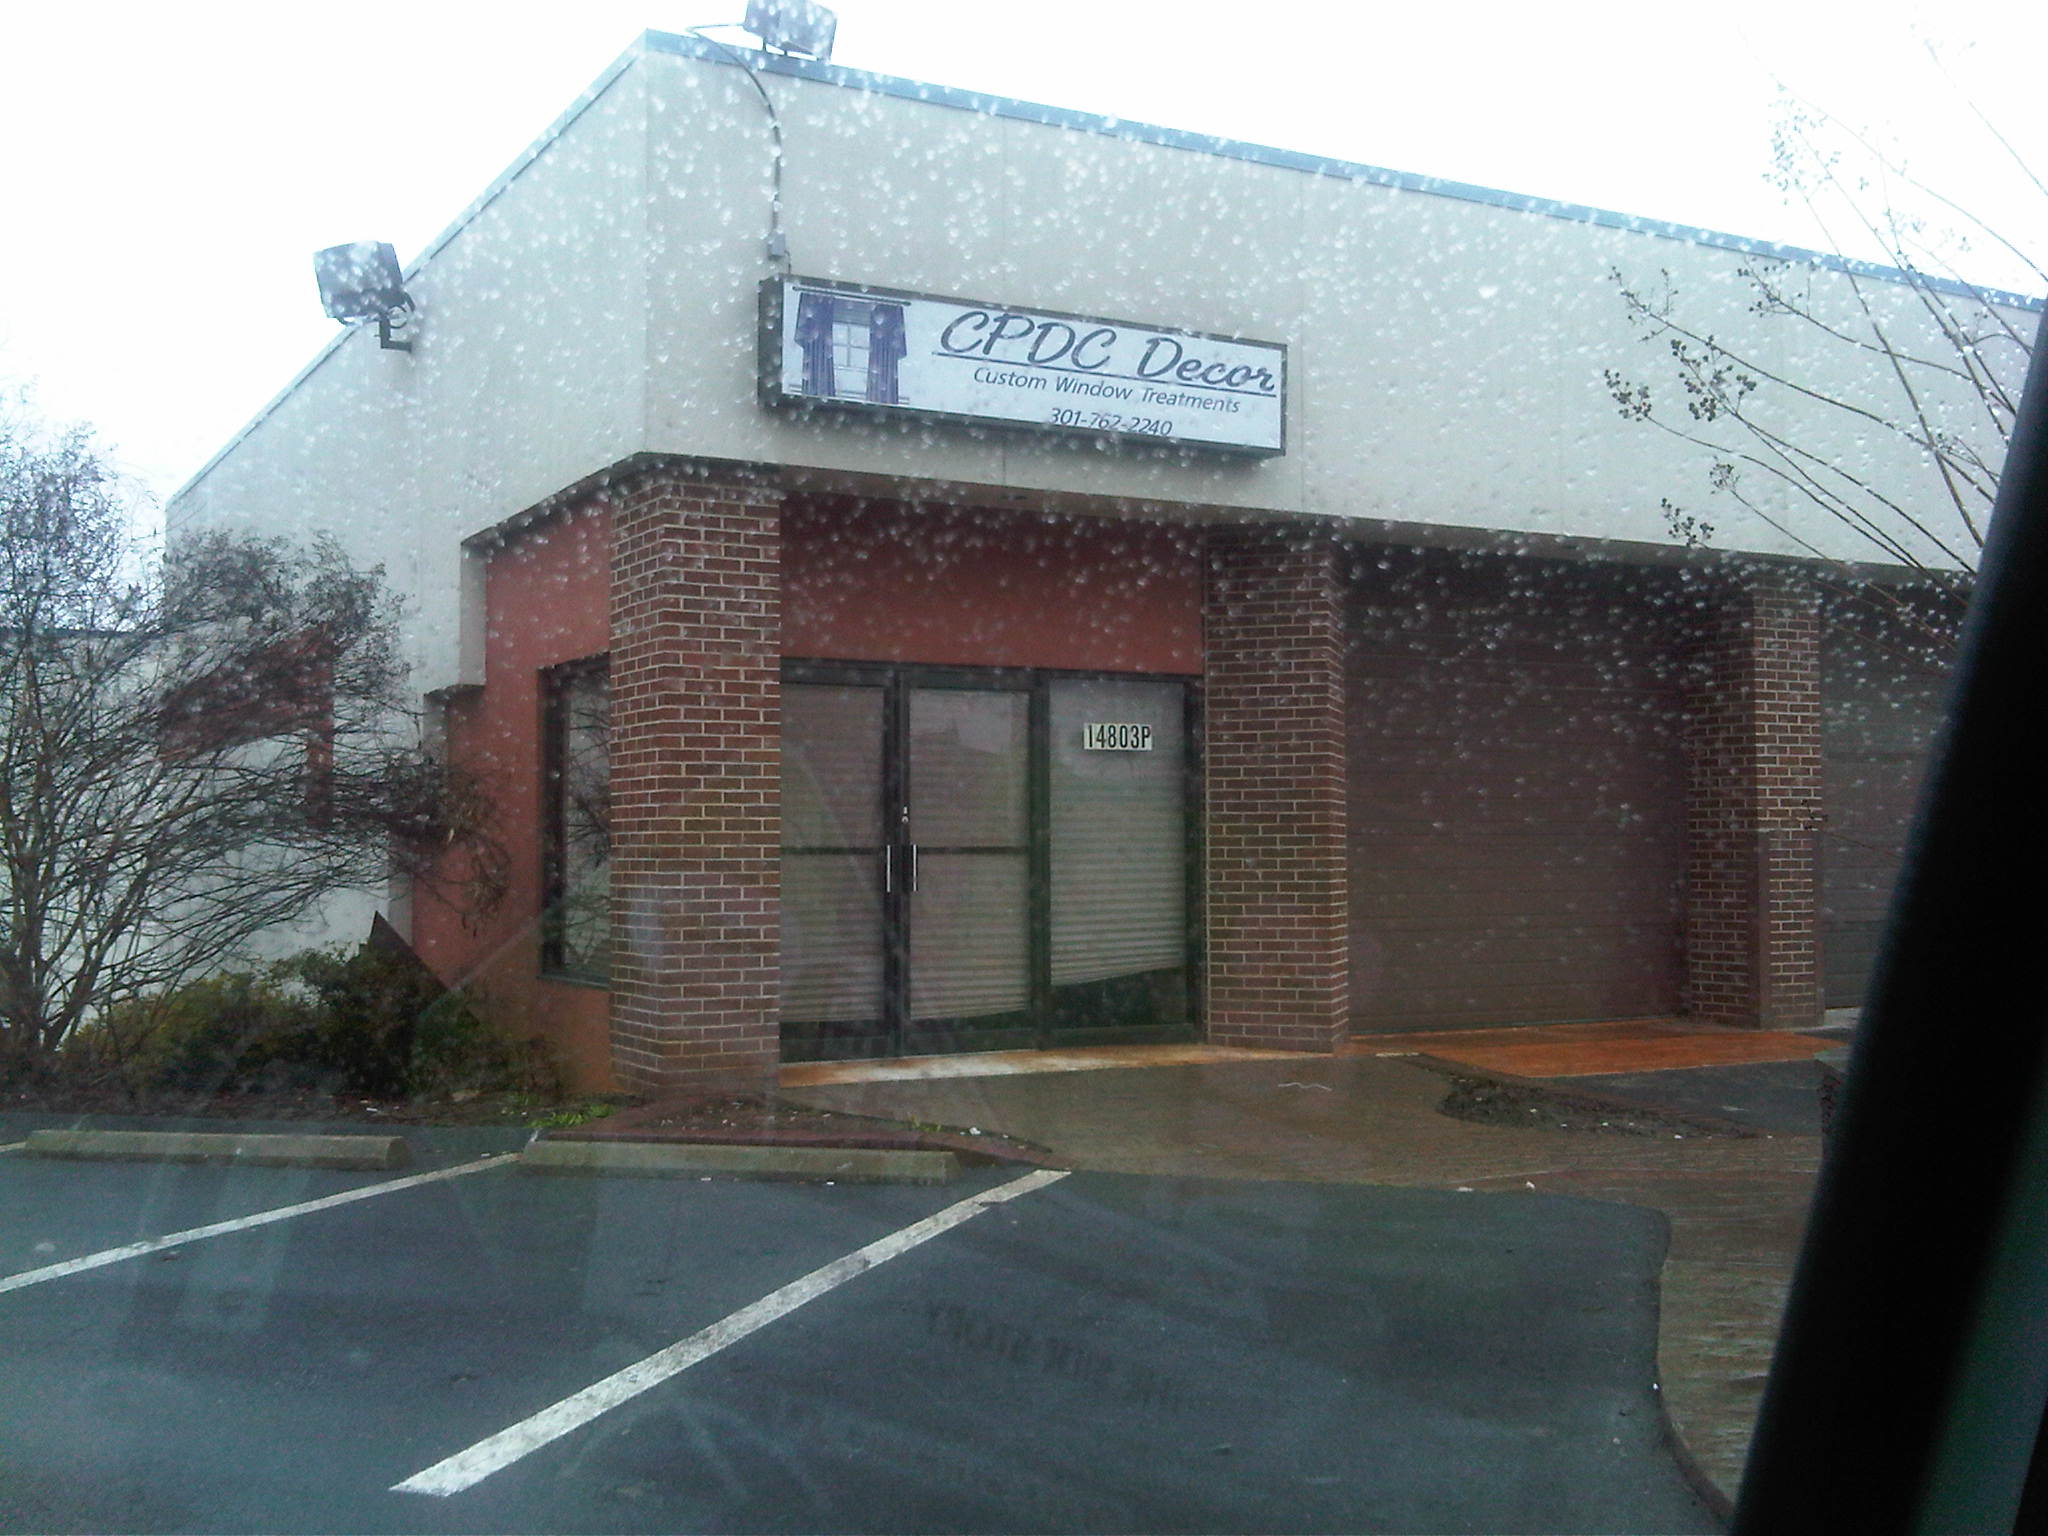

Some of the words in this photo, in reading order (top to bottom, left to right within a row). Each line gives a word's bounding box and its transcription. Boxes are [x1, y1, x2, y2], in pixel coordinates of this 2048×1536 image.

[941, 310, 1117, 370] CPDC
[1137, 337, 1276, 392] Decor
[973, 366, 1047, 392] Custom
[1056, 377, 1133, 401] Window
[1142, 387, 1241, 414] Treatments
[1050, 407, 1173, 436] 301-762-2240
[1087, 724, 1151, 749] 14803P
